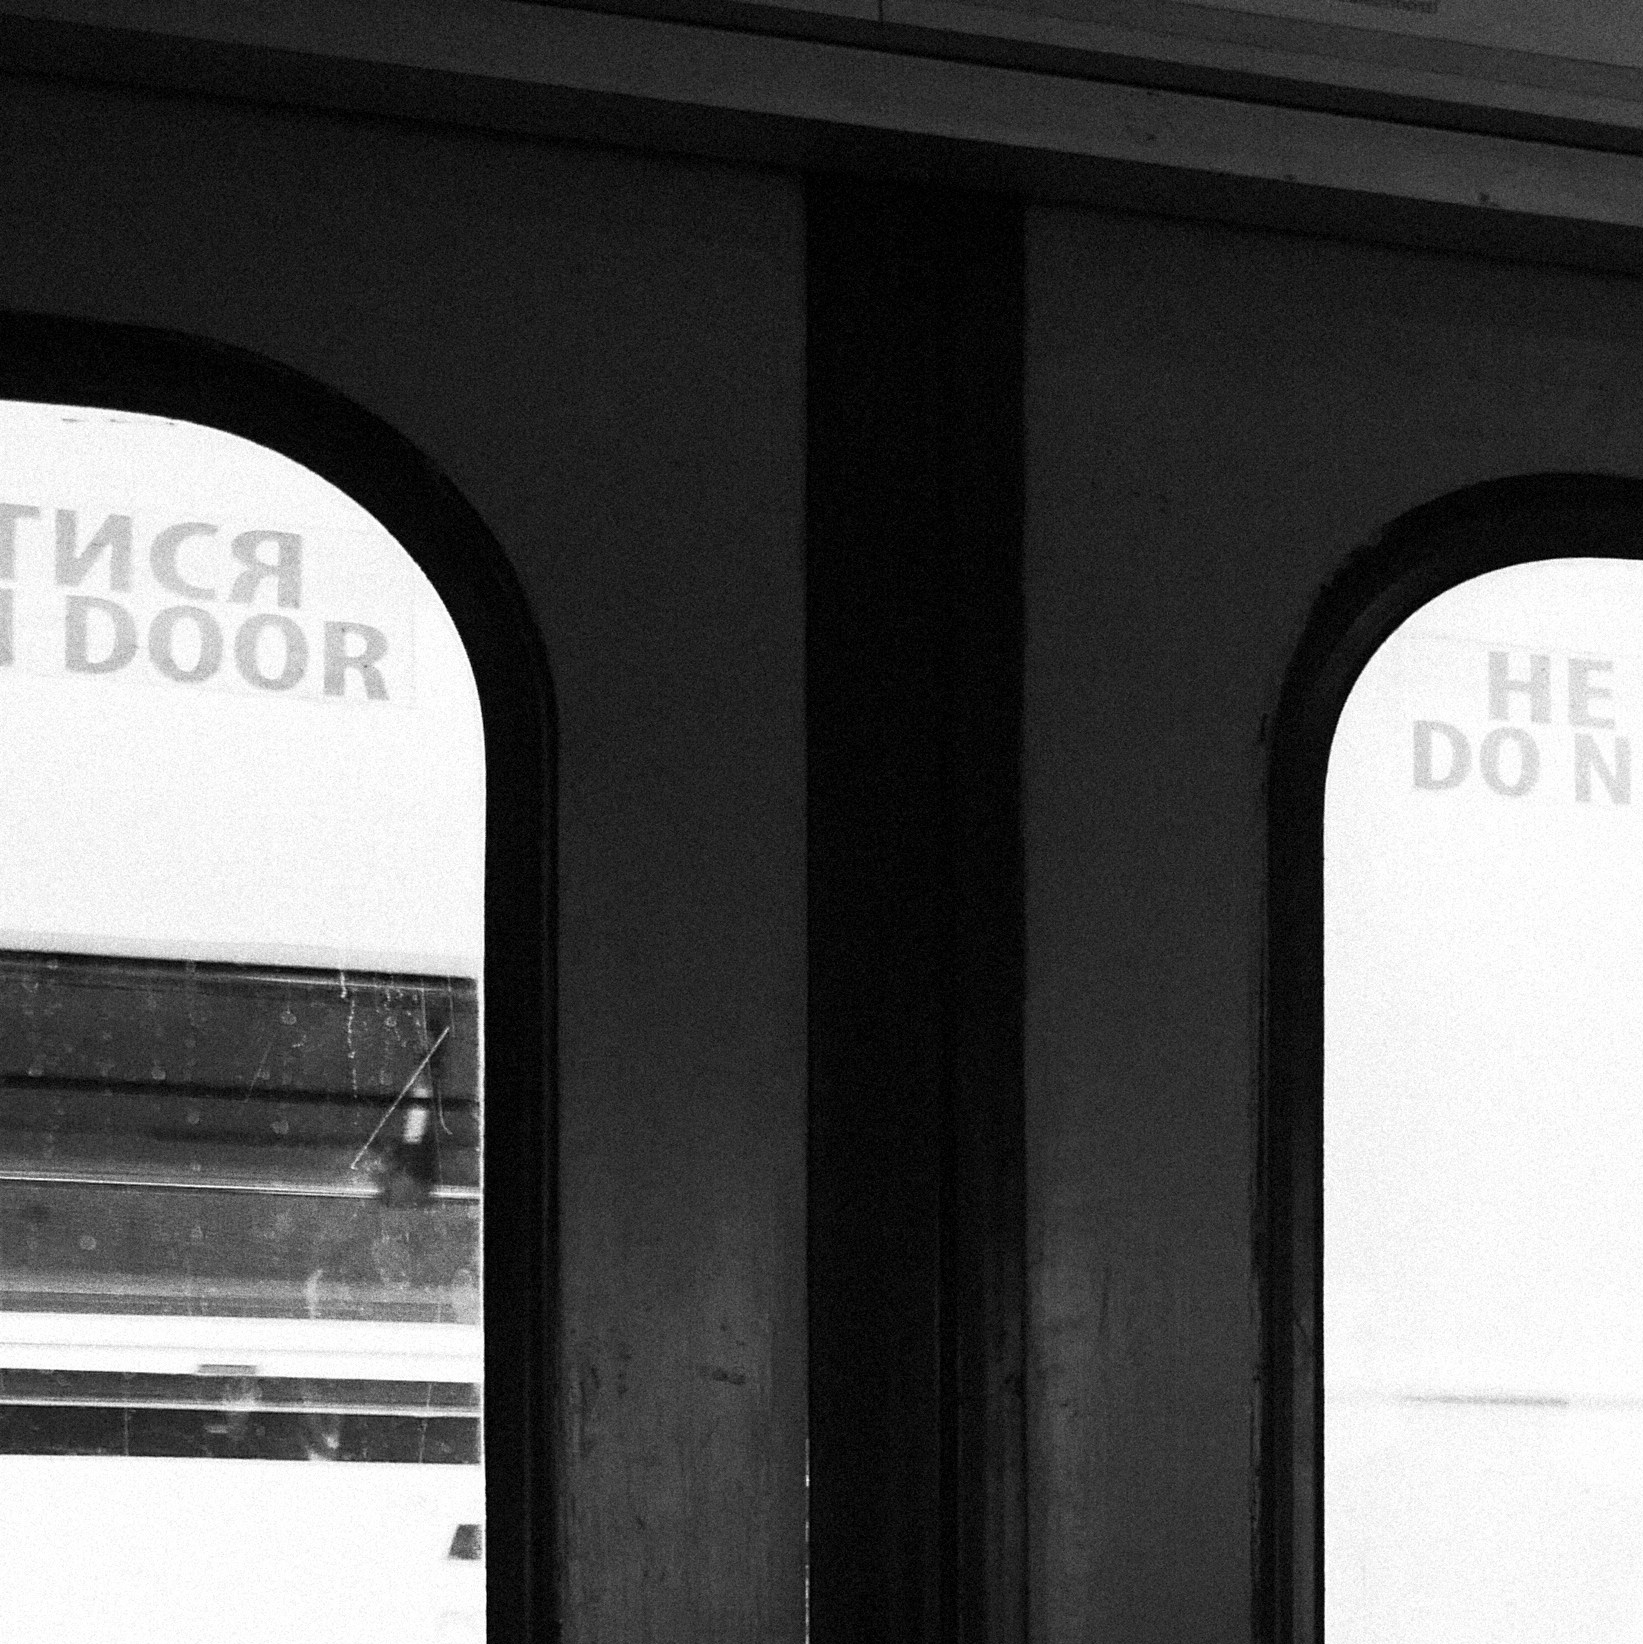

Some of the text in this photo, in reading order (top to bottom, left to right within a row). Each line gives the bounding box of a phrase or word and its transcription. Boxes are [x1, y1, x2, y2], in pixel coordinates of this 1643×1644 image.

[64, 594, 391, 701] DOOR
[1486, 650, 1618, 730] НЕ
[1410, 718, 1543, 799] DO
